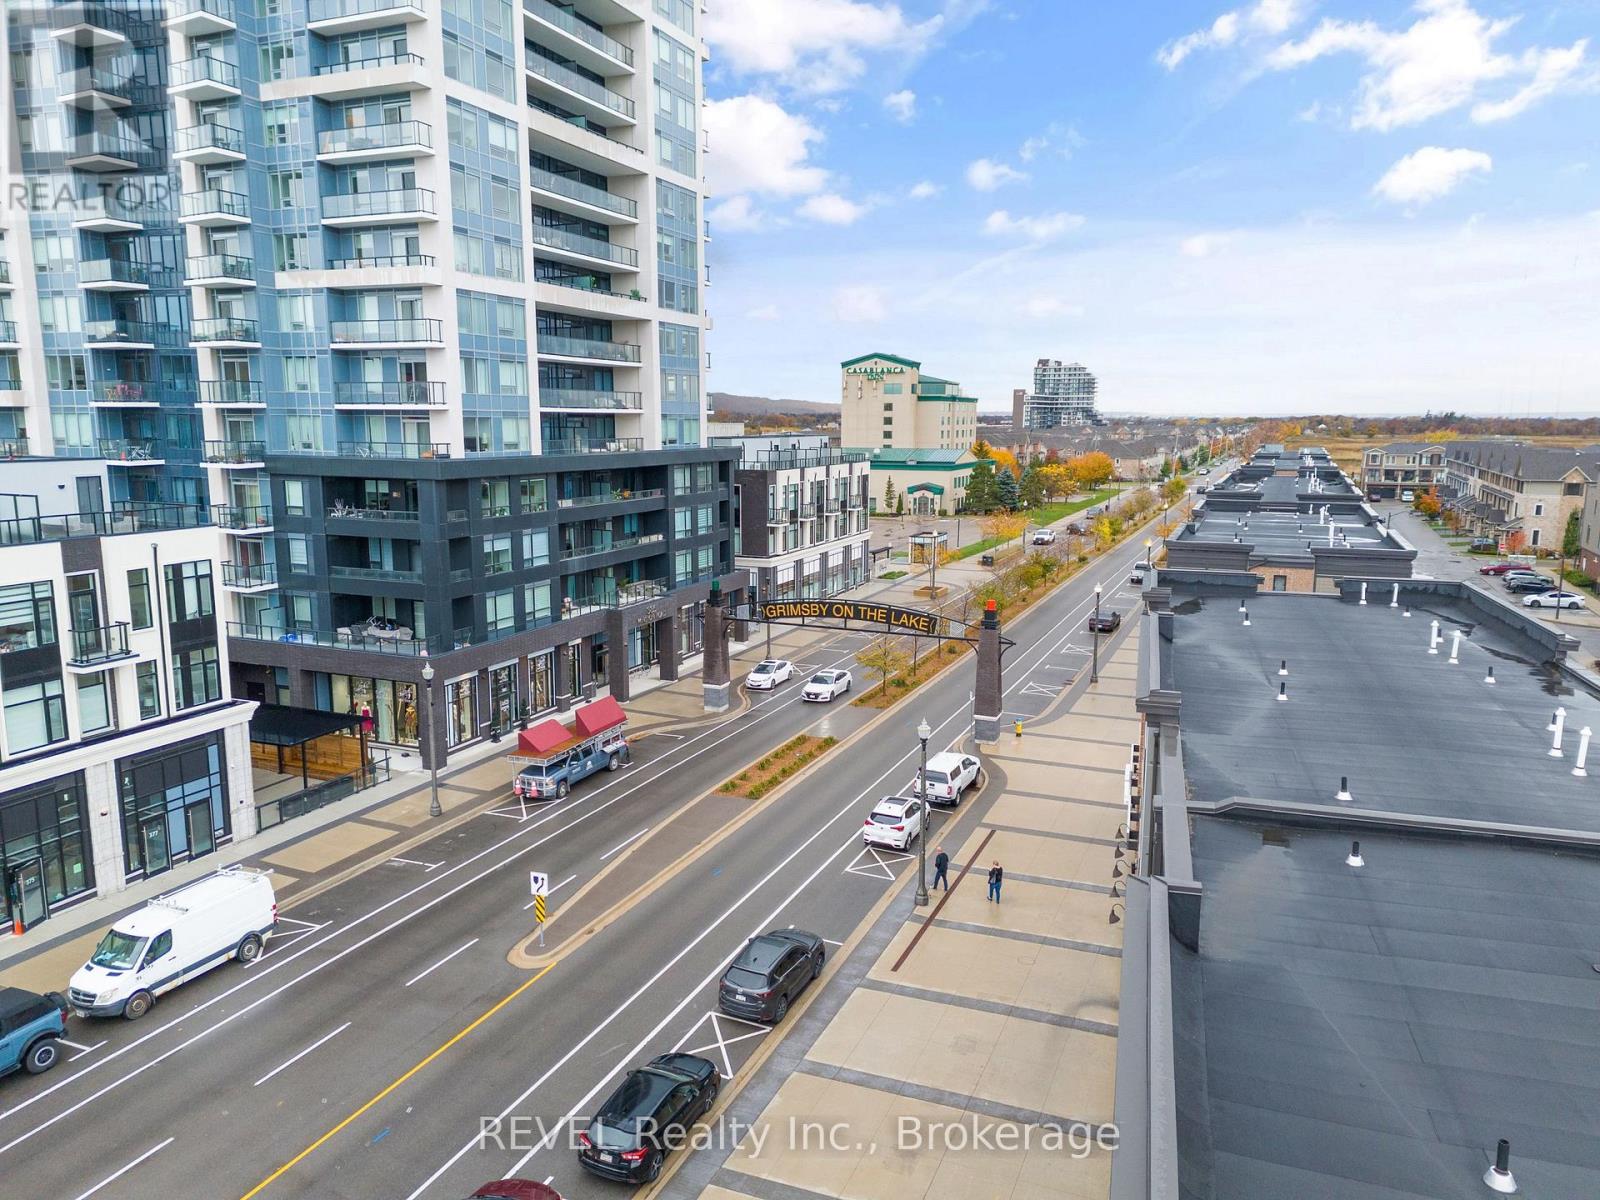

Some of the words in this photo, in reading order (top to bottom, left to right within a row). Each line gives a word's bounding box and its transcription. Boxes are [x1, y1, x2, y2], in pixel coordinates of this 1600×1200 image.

[846, 367, 904, 375] CASABLANCA
[766, 603, 829, 618] GRIMSBY
[832, 604, 854, 618] ON
[858, 606, 888, 622] THE
[891, 611, 930, 631] LAKE
